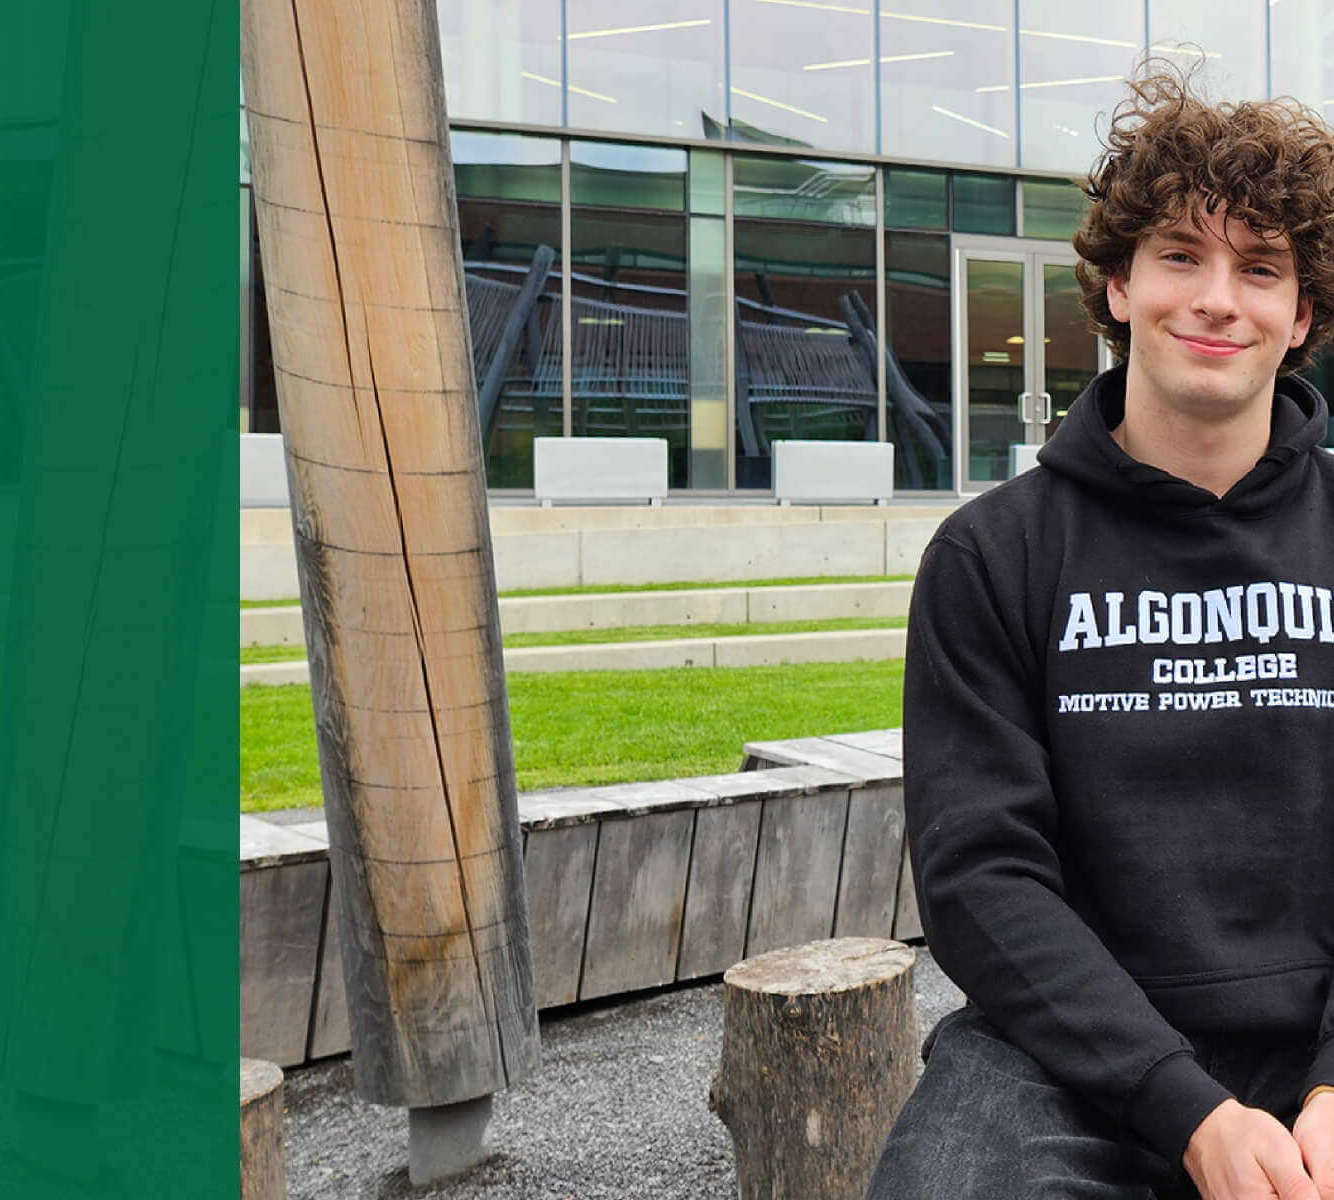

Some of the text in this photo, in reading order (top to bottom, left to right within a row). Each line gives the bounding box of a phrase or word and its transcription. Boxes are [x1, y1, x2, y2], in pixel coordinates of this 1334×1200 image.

[1153, 653, 1298, 685] COLLEGE
[1058, 692, 1150, 713] MOTIVE
[1158, 690, 1243, 711] POWER
